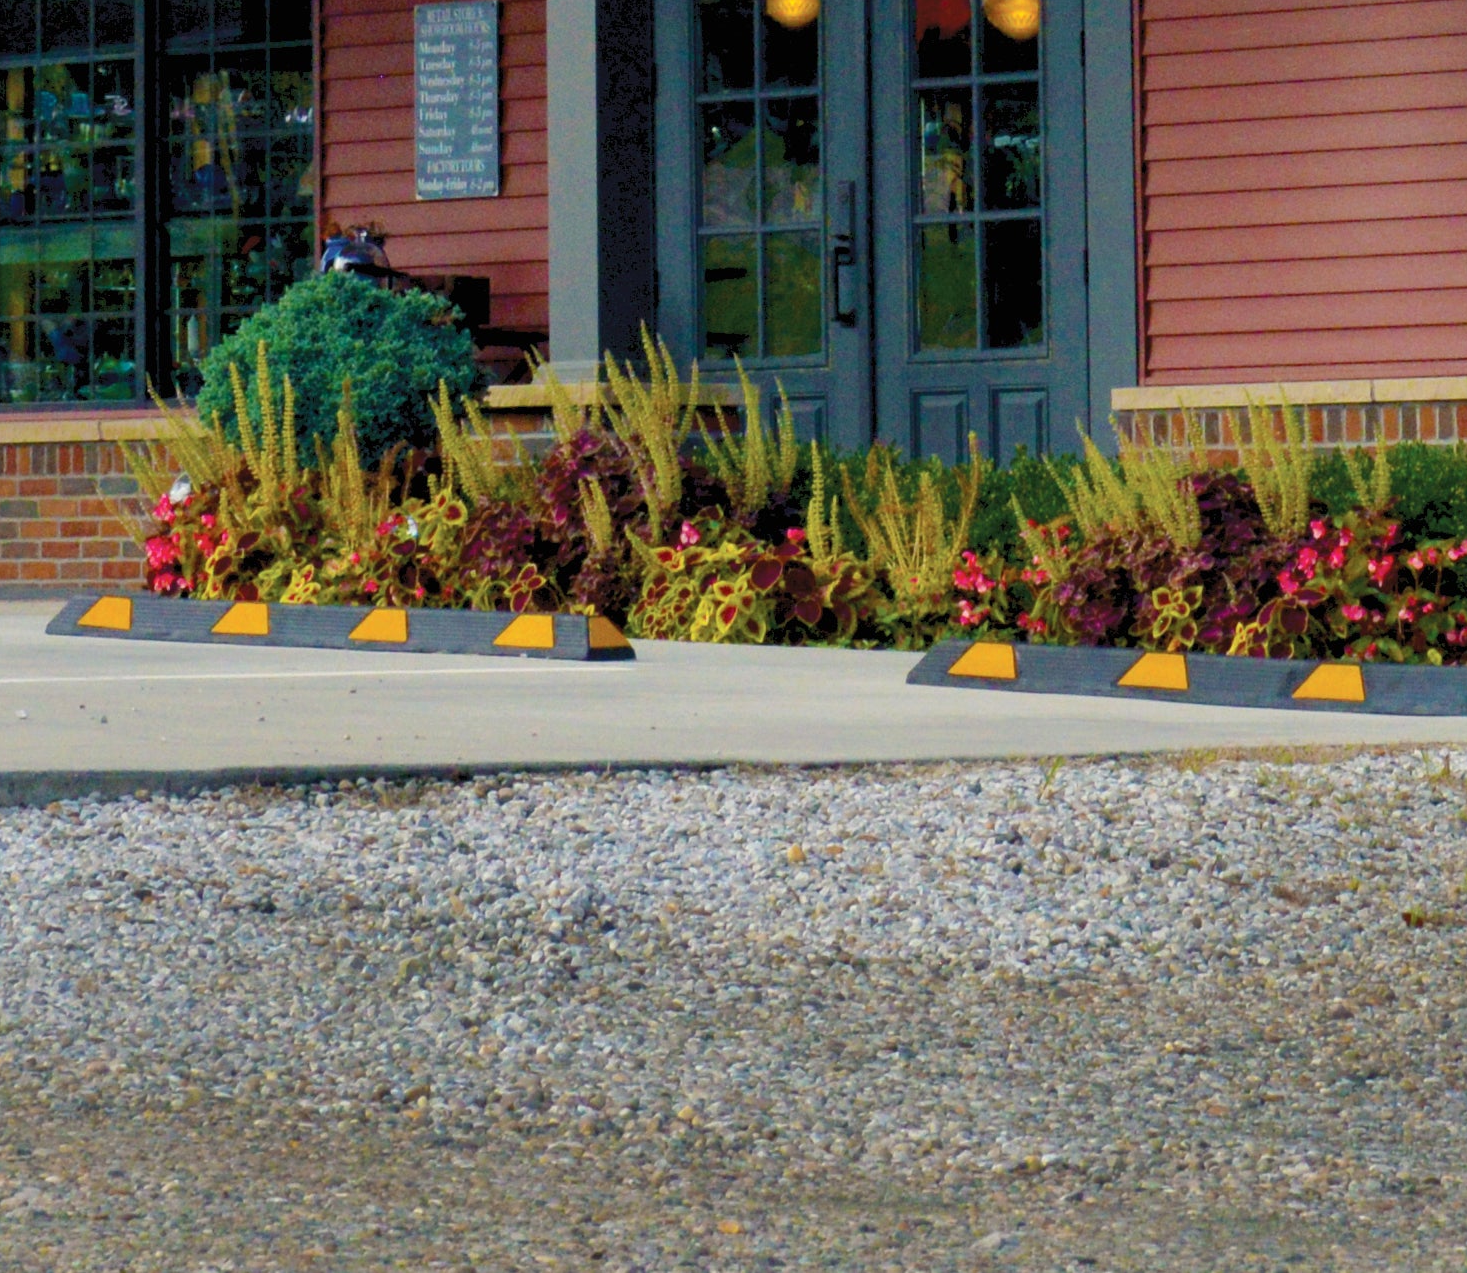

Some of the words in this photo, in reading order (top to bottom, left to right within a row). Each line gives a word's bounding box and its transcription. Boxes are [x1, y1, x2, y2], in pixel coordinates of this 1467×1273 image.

[419, 40, 455, 56] Monday
[419, 57, 456, 73] Tuesday
[419, 73, 464, 89] Wednesday
[419, 90, 459, 106] Thursday
[419, 107, 448, 123] Friday
[418, 124, 456, 140] Saturday
[418, 141, 453, 157] Sunday
